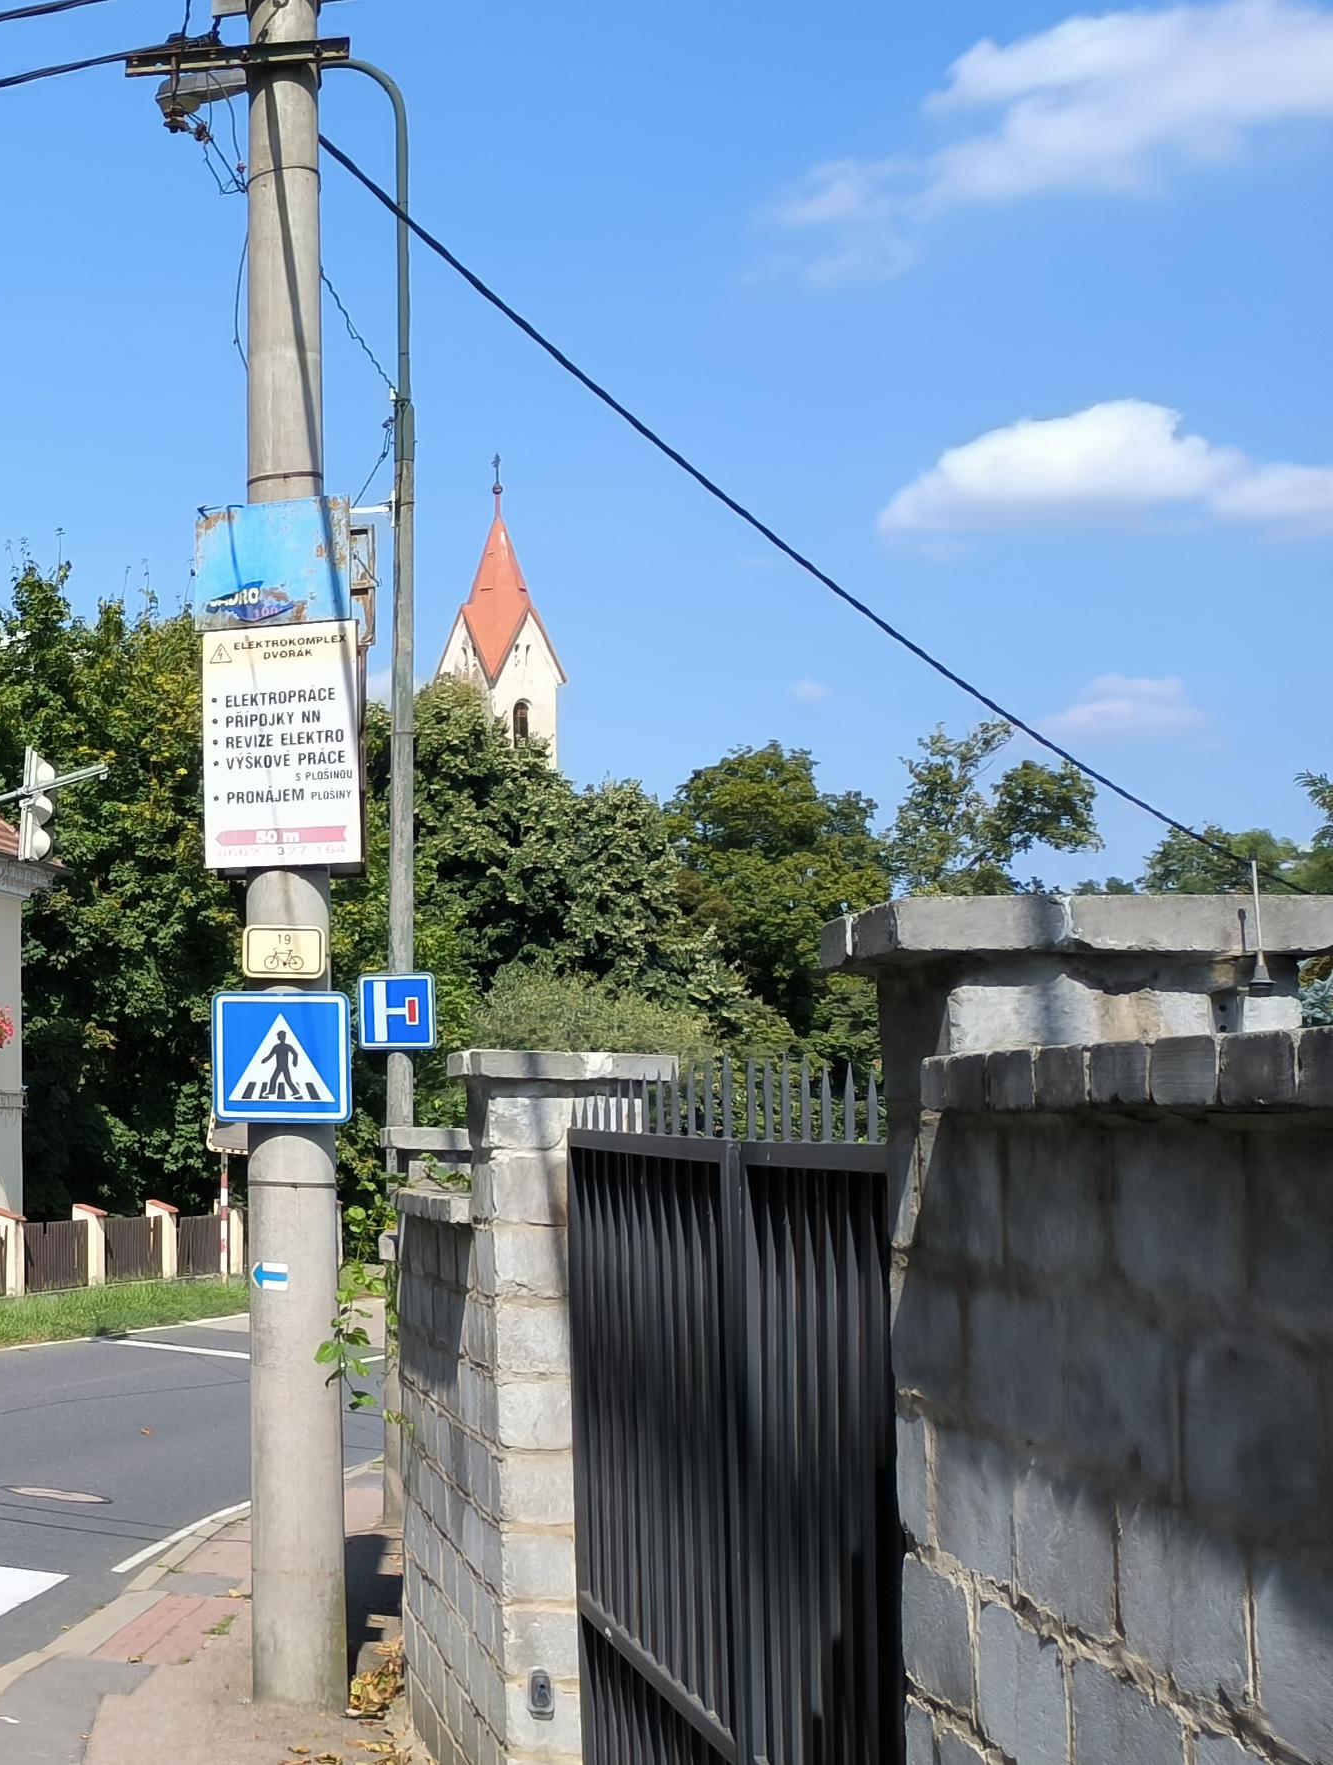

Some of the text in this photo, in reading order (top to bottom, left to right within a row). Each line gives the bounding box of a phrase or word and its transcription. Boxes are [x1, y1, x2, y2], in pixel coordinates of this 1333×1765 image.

[234, 634, 346, 650] ELEKTROKOMPLEX
[225, 685, 336, 708] ELEKTROPRÁCE
[226, 709, 321, 728] PŘÍPOJKY NN
[226, 728, 344, 749] REVIZE ELEKTRO
[226, 747, 346, 770] VÝŠKOVÉ PRÁCE
[295, 768, 353, 781] S PLOŠINOU
[227, 785, 352, 804] PRONÁJEM PLOŠINY
[256, 830, 300, 844] 50 m
[276, 845, 307, 856] 327
[278, 934, 291, 945] 19
